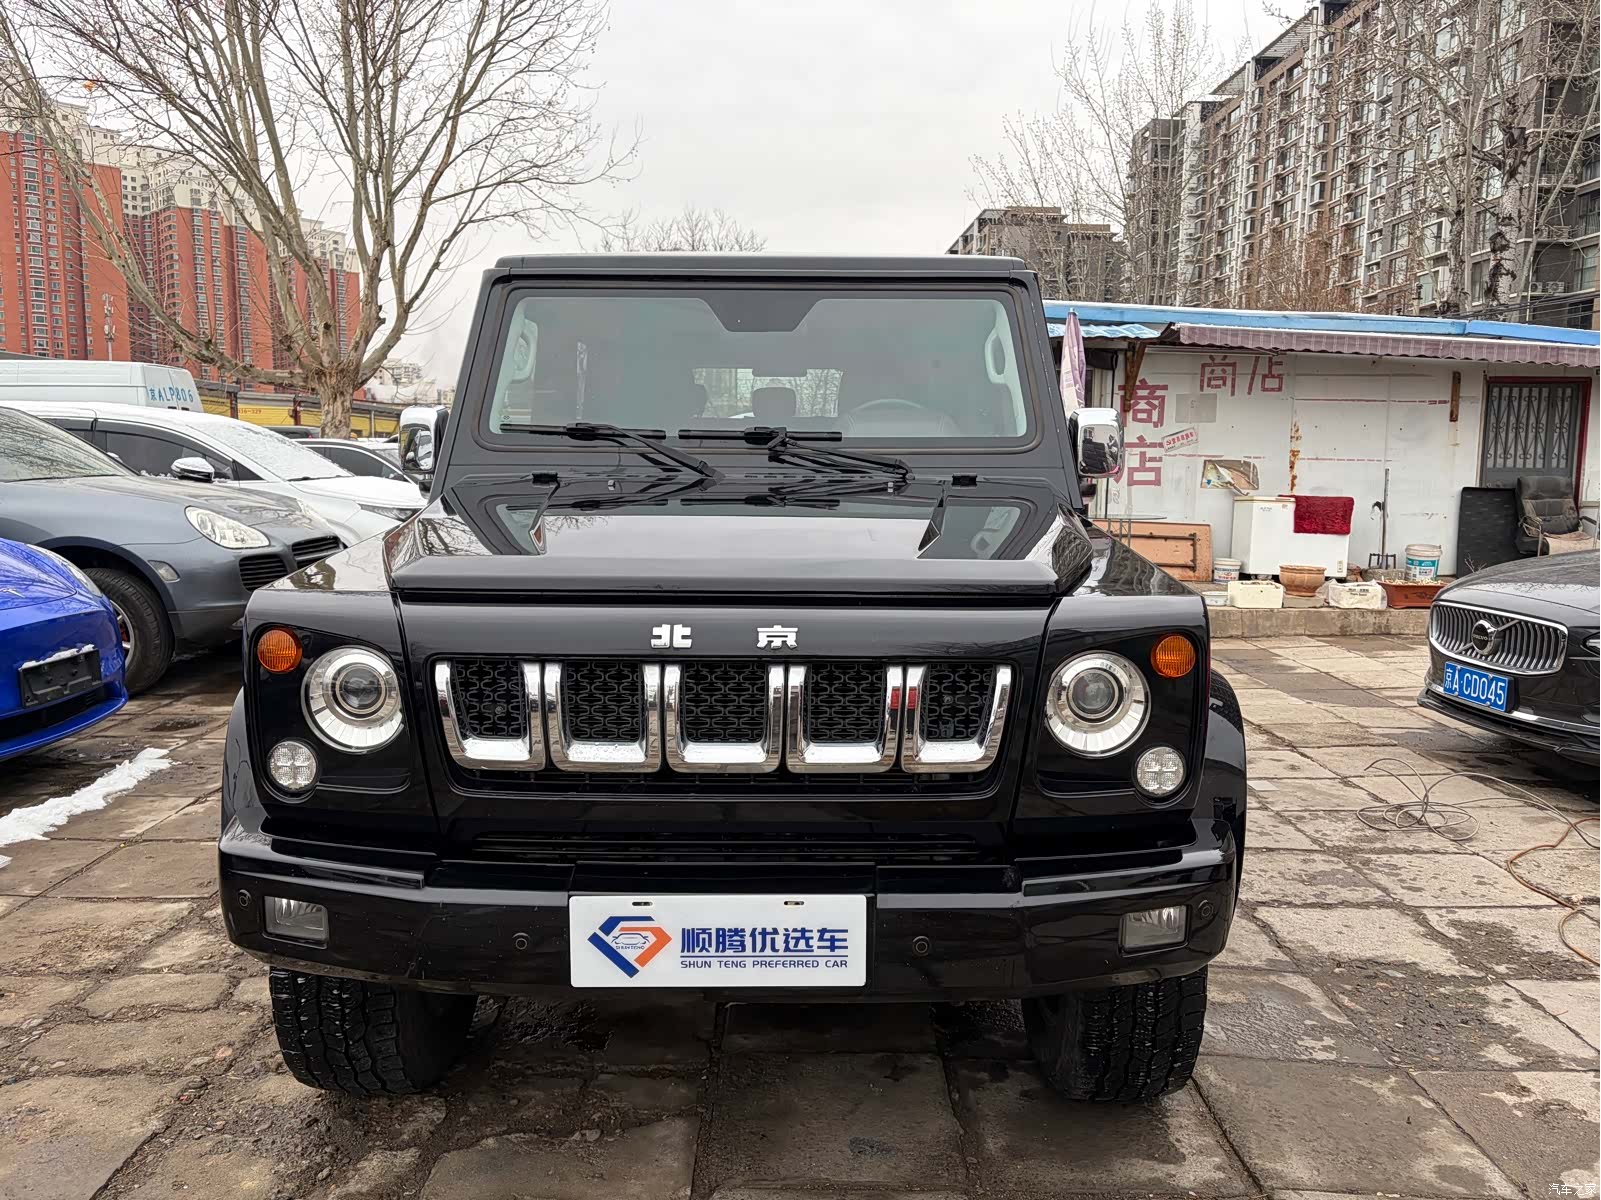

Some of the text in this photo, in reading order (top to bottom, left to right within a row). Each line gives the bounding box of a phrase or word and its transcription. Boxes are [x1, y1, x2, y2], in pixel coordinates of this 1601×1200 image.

[148, 386, 194, 403] 京ALP806
[1112, 377, 1169, 487] 商店
[650, 623, 799, 649] 北京
[680, 927, 849, 953] 顺腾优选车
[680, 959, 849, 969] SHUN TENG PREFERRED CAR
